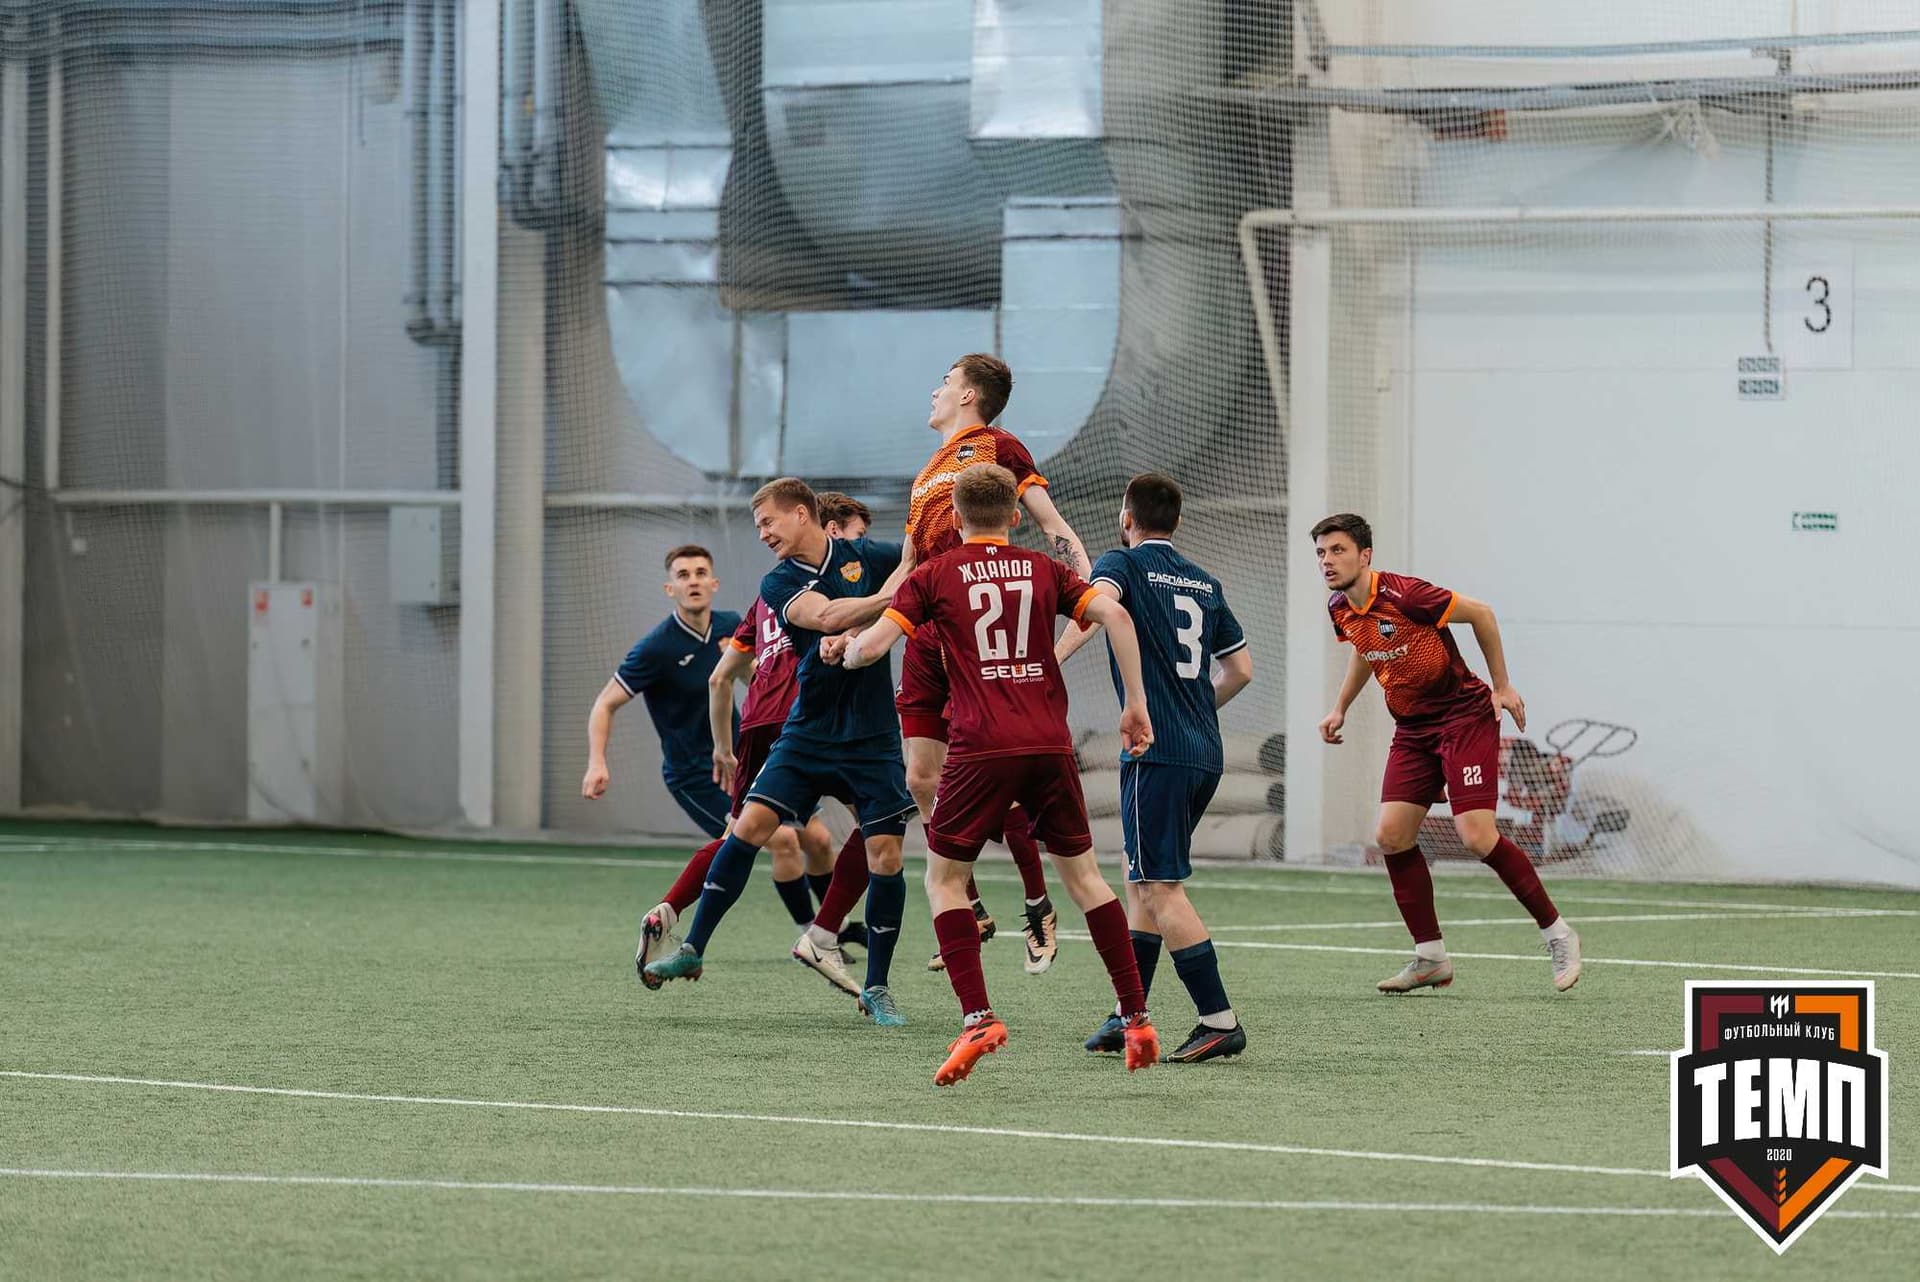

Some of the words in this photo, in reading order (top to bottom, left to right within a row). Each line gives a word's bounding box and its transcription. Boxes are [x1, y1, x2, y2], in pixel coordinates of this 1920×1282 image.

[1804, 276, 1832, 334] 3
[957, 559, 1033, 584] ЖДАНОВ
[968, 579, 1034, 662] 27
[1173, 594, 1204, 680] 3
[980, 662, 1044, 680] SEUS
[1462, 765, 1483, 786] 22
